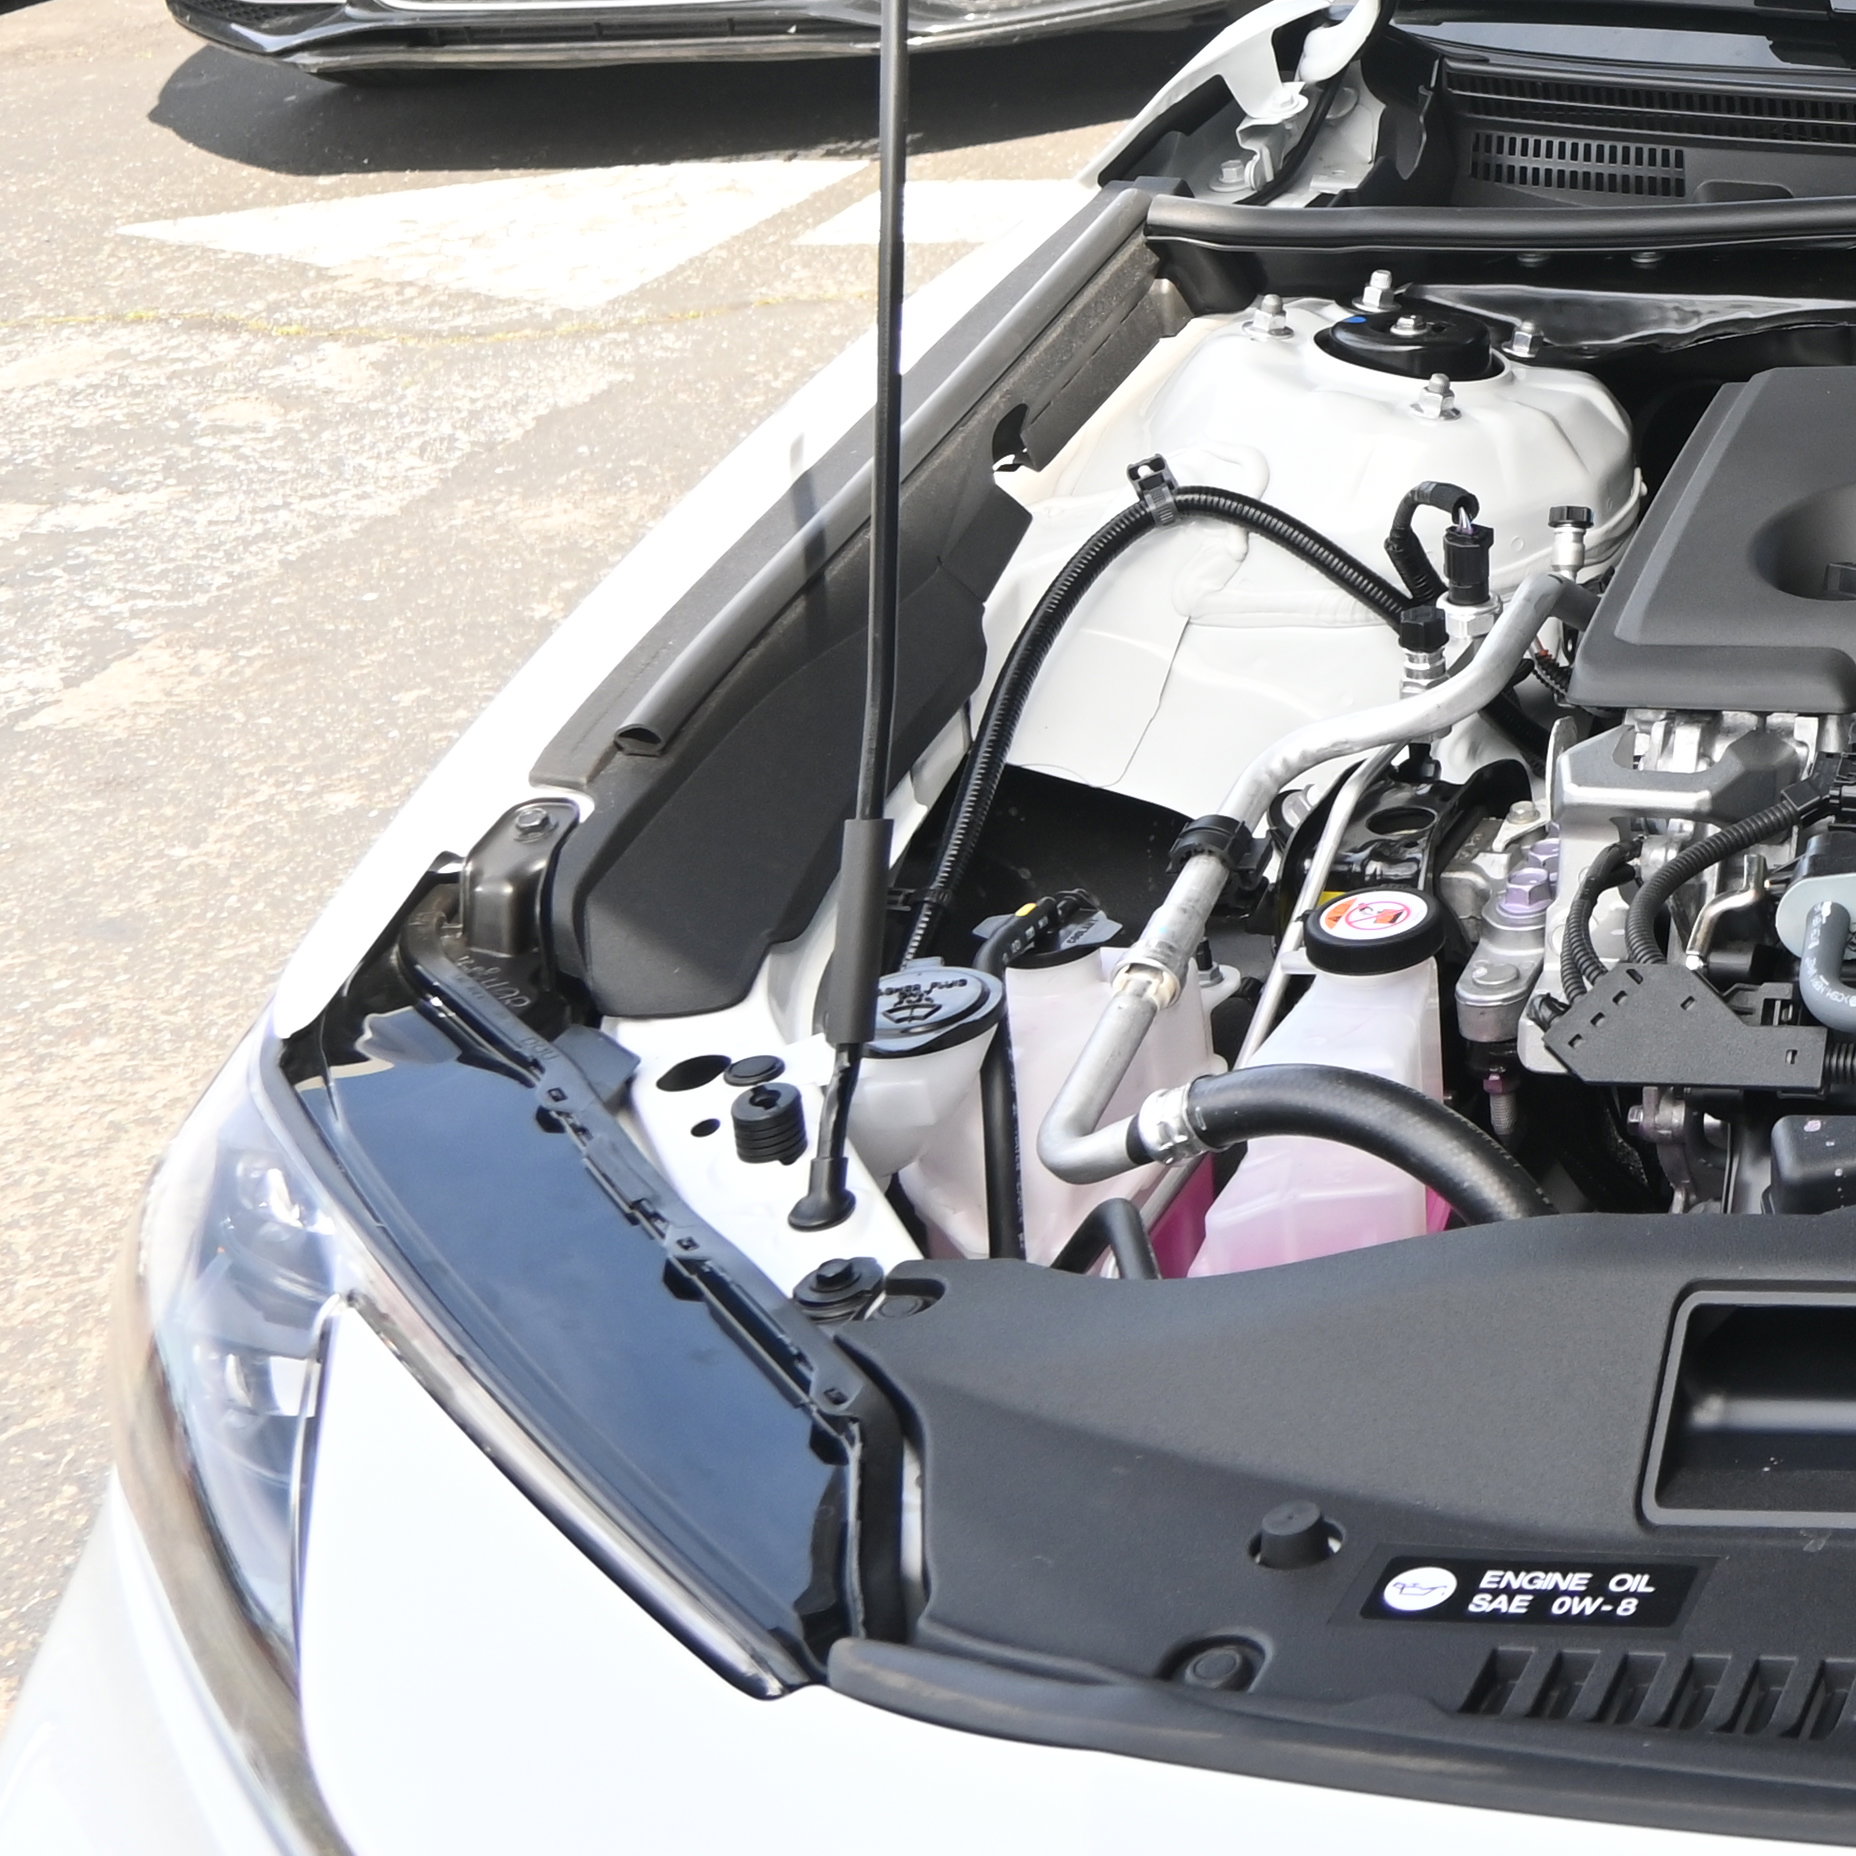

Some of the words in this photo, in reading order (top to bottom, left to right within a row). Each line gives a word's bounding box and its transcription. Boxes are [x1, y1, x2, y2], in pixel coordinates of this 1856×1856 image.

[1479, 1570, 1593, 1592] ENGINE
[1608, 1573, 1656, 1593] OIL
[1467, 1593, 1534, 1614] SAE
[1550, 1596, 1639, 1617] 0W-8
